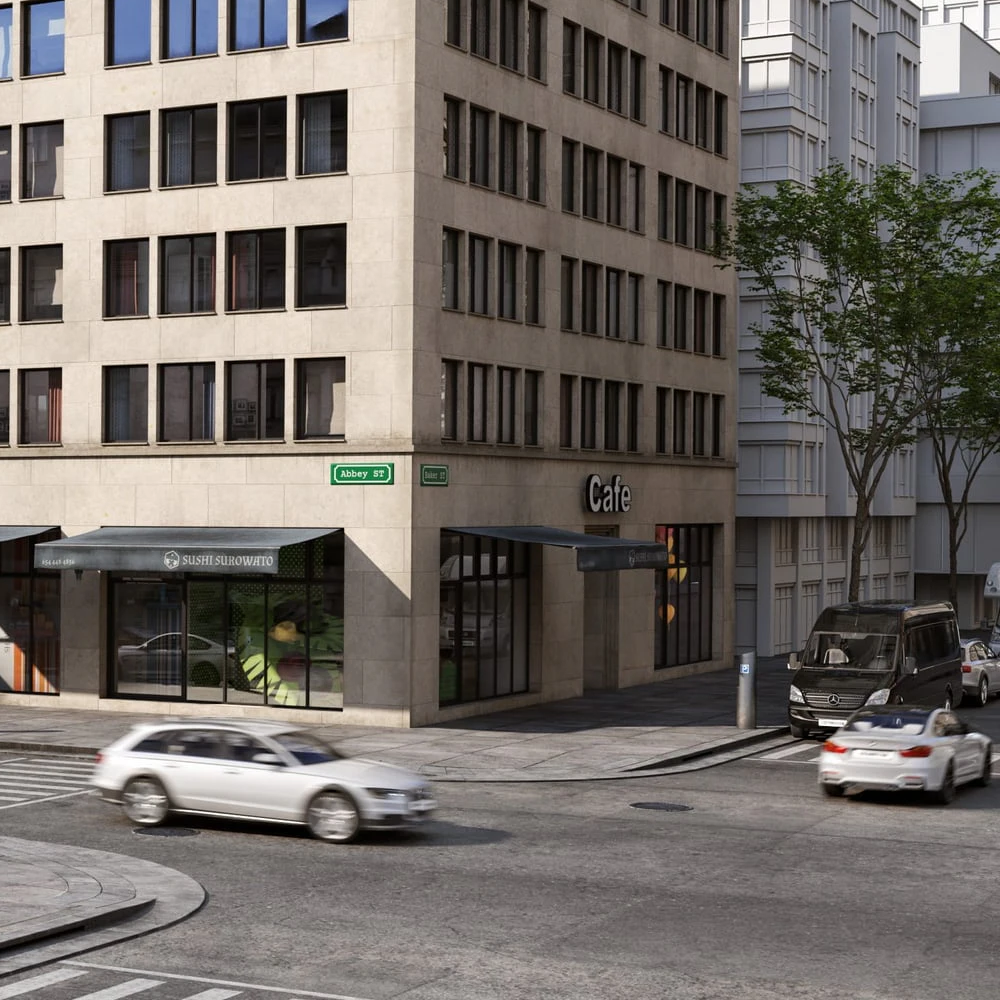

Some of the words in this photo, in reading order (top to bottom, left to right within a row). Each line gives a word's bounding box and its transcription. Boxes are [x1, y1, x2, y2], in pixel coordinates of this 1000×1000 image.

[340, 470, 368, 479] Abbey
[588, 474, 631, 512] Cafe
[182, 554, 213, 566] SUSHI
[215, 555, 274, 567] SUROWATO
